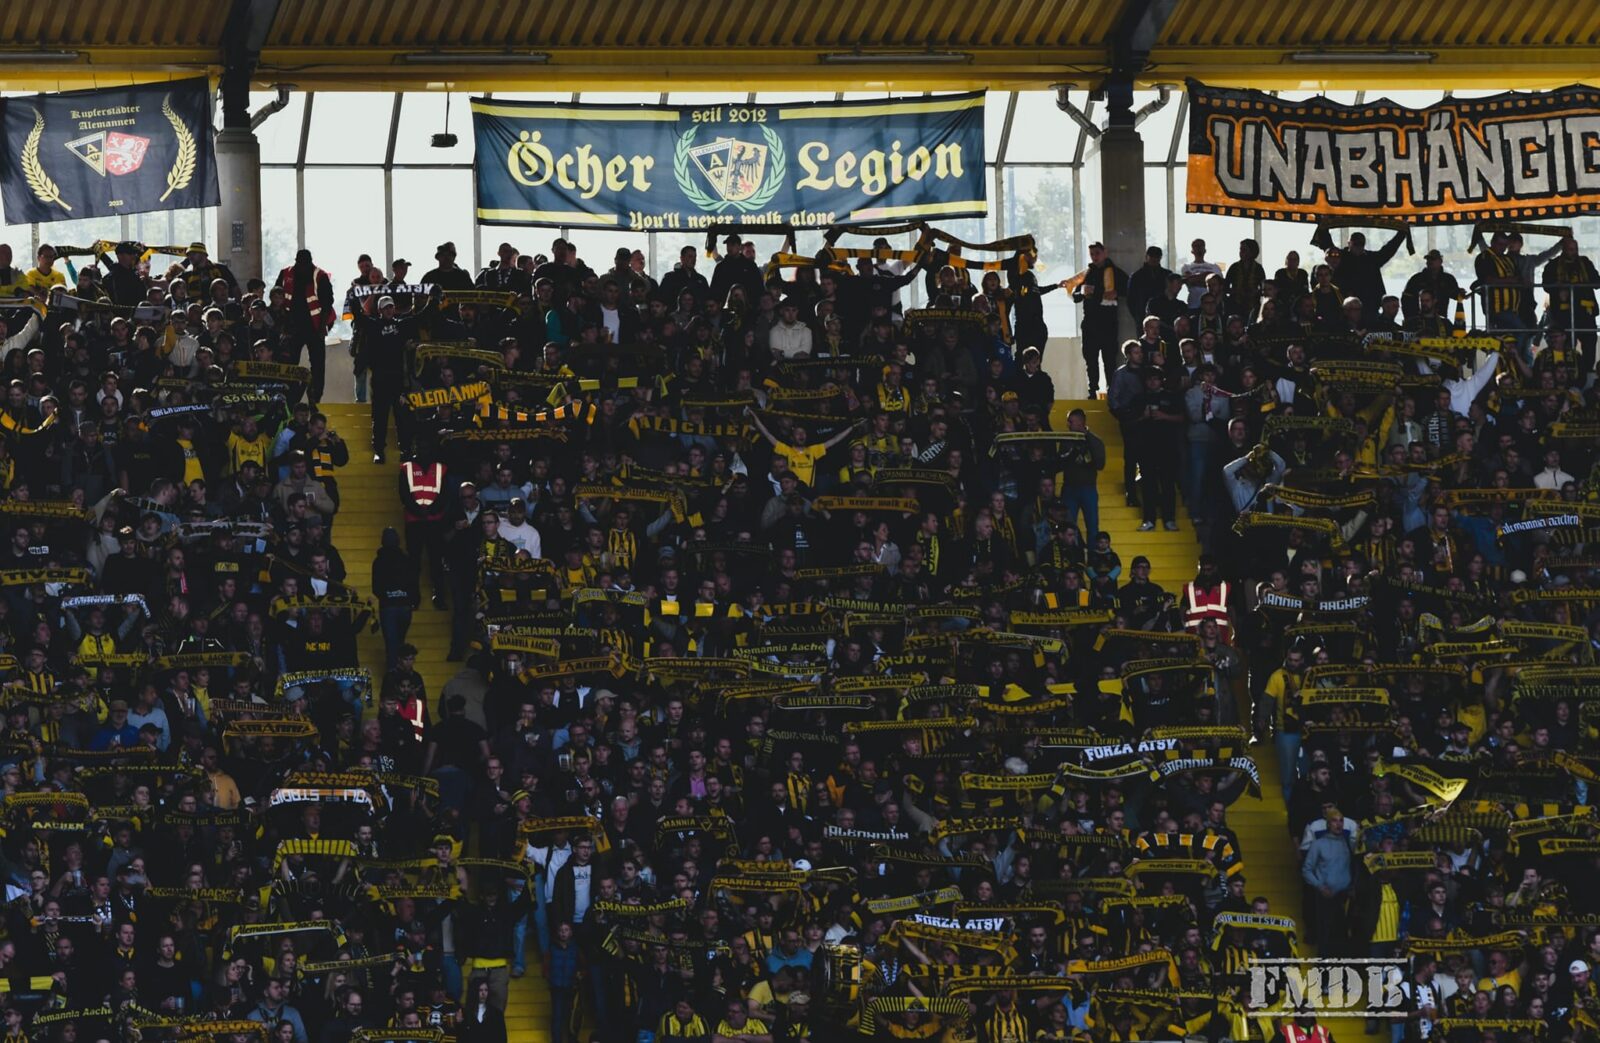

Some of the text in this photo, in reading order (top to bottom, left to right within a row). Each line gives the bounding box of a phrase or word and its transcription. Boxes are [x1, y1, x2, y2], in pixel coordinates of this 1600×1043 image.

[70, 106, 140, 119] Kupferstädter
[729, 108, 767, 122] 2012
[79, 118, 136, 129] Alemannen
[507, 131, 964, 199] Öcher Legion
[629, 212, 681, 230] You'll
[741, 211, 782, 225] walk
[790, 211, 836, 226] alone
[353, 285, 391, 298] ORZA
[5, 569, 85, 580] TIVOLI
[824, 597, 879, 613] ALEMANNIA
[1504, 627, 1554, 638] ALEMANNIA
[732, 643, 788, 656] Alemannia
[868, 680, 915, 688] ALEMANNIA
[787, 697, 829, 706] ALEMANNIA
[1048, 736, 1090, 745] ALEMANNIA
[1085, 738, 1177, 761] FORZA ATSV
[986, 775, 1054, 784] ALEMANNIA
[215, 815, 240, 825] Kraft
[663, 818, 696, 830] MANNIA
[594, 899, 647, 913] LEMANNIA
[914, 913, 1004, 931] FORZA ATSV
